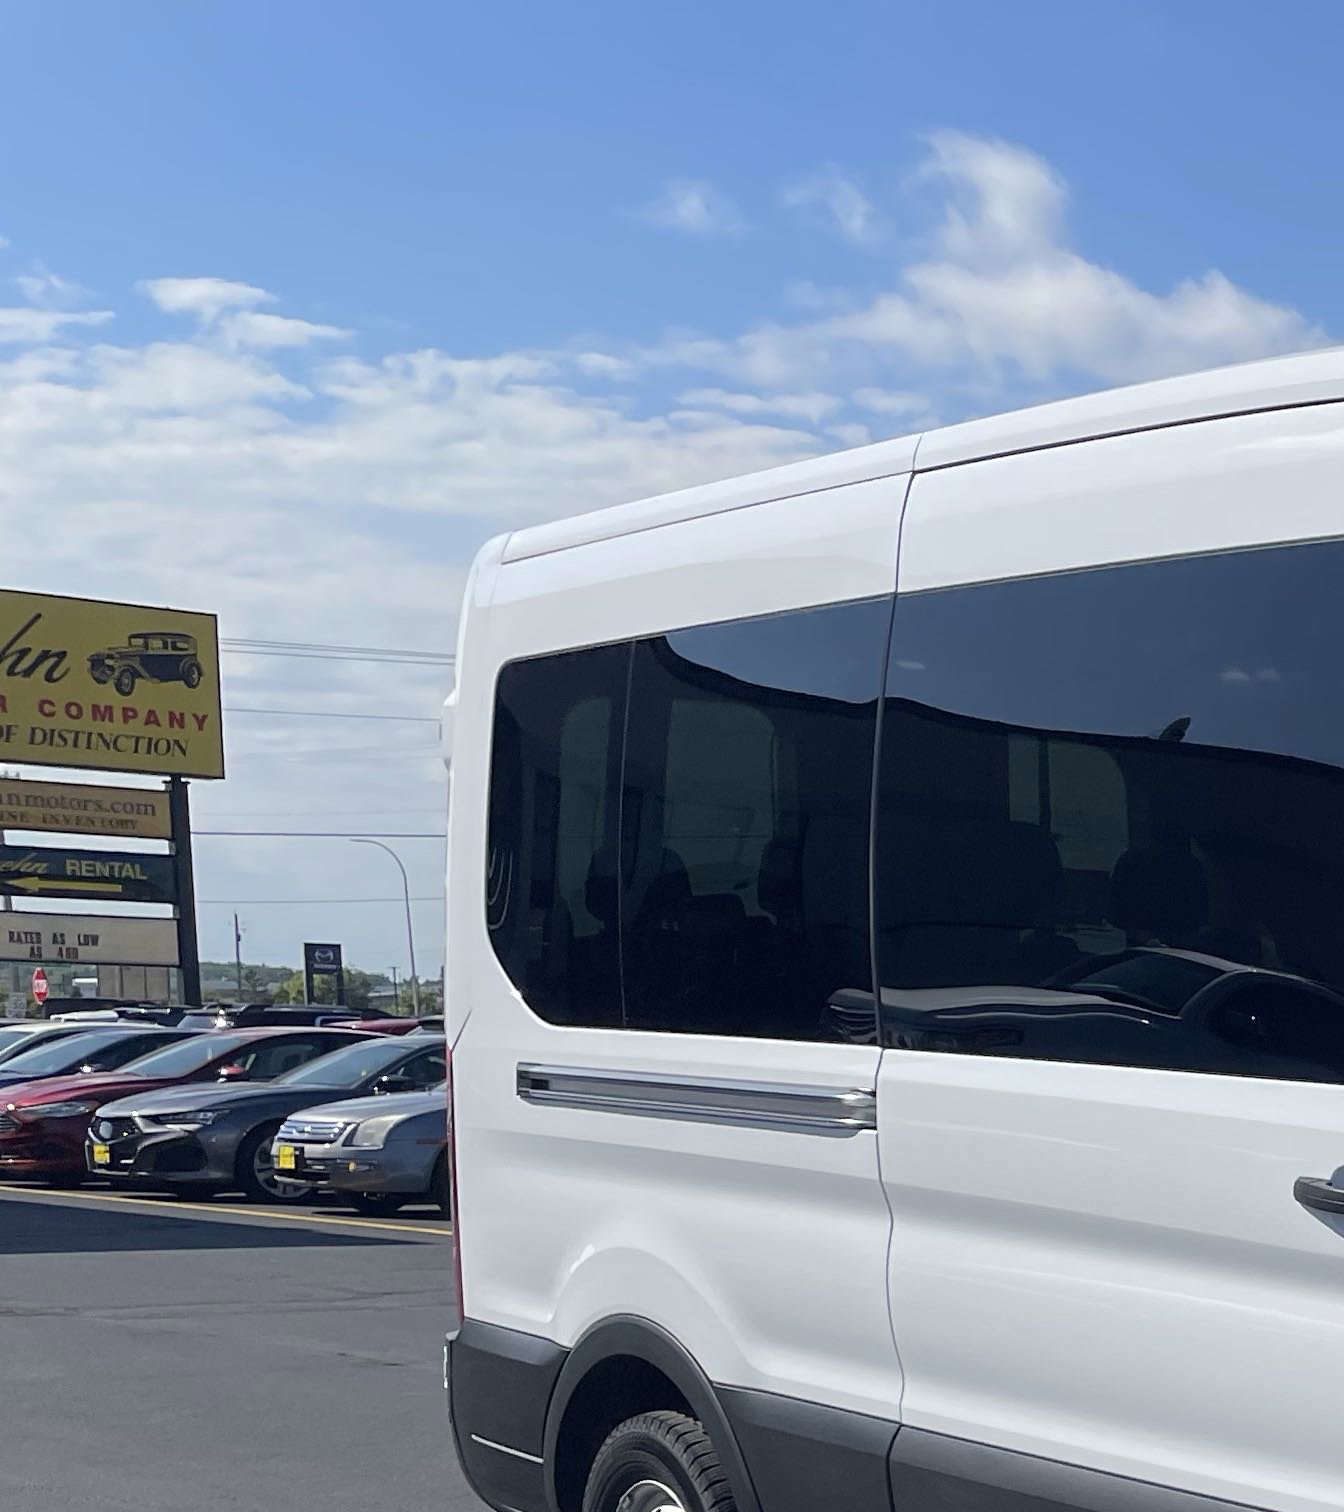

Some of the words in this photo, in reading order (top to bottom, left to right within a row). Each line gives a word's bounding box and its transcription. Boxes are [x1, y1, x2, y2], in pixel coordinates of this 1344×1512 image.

[38, 699, 209, 732] COMPANY
[29, 726, 189, 758] DISTINCTION
[0, 791, 157, 817] nmotors.com
[42, 812, 138, 830] INVENTORY
[65, 858, 148, 880] RENTAL
[8, 930, 42, 945] RATES
[52, 932, 66, 945] AS
[78, 933, 99, 946] LOW
